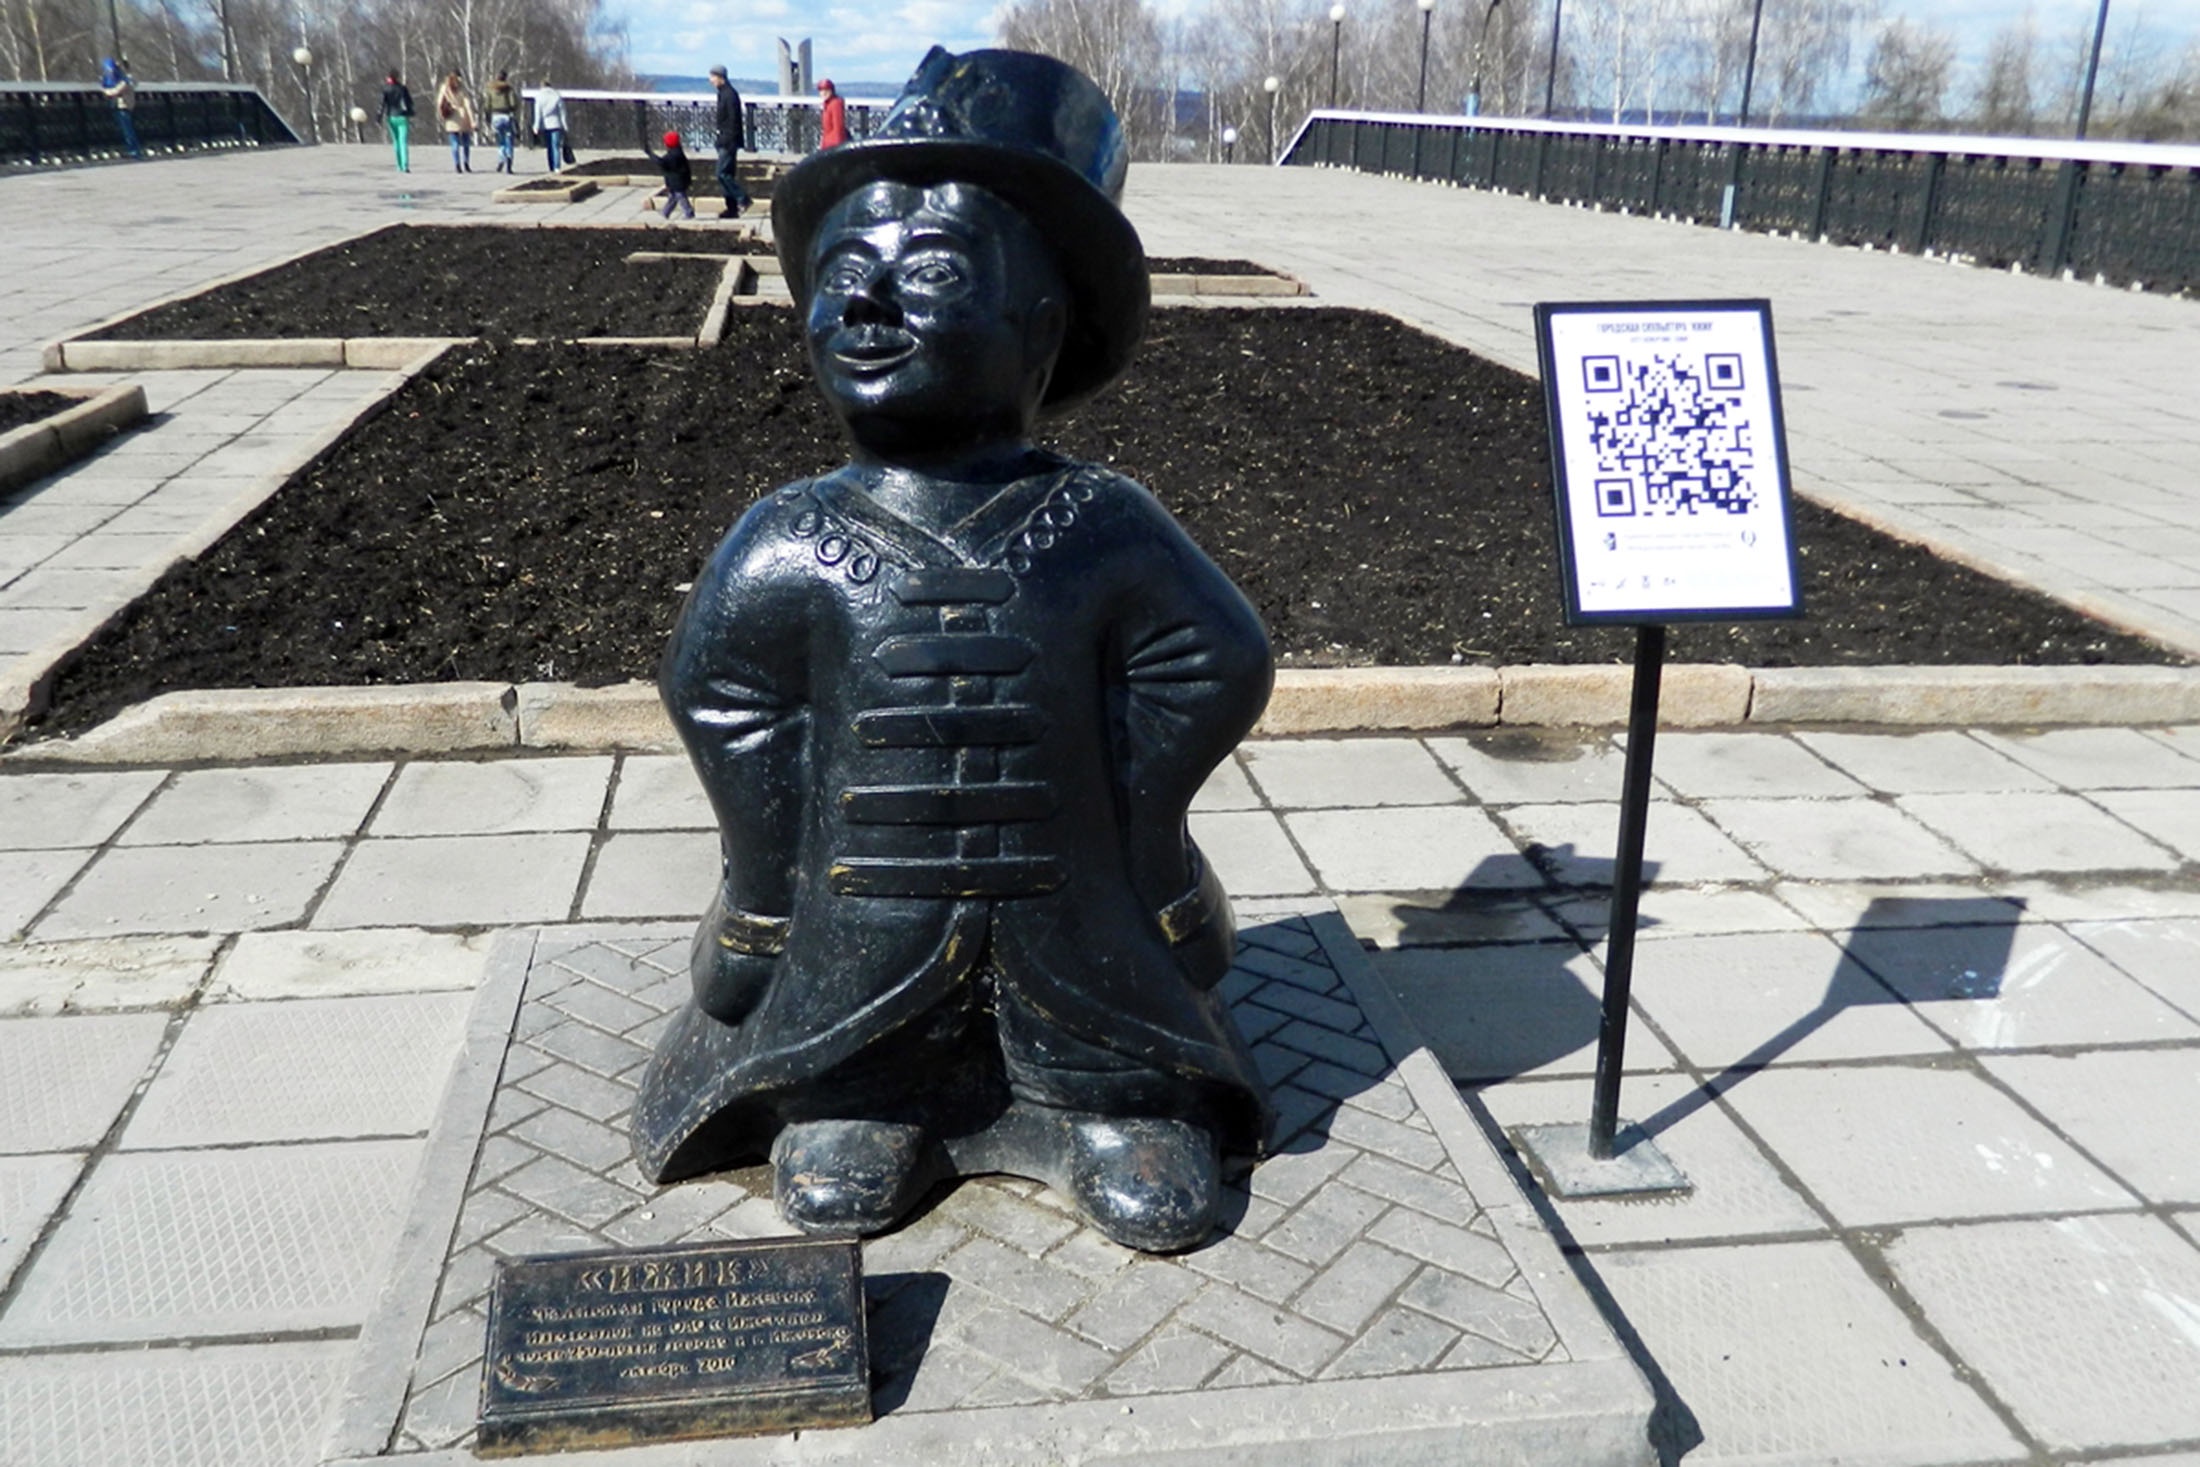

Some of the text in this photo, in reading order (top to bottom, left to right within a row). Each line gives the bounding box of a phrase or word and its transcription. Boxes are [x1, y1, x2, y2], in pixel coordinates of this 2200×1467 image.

[579, 1258, 770, 1294] «ИЖИК»
[652, 1296, 720, 1317] города
[642, 1323, 663, 1338] на
[669, 1318, 705, 1336] ОАО
[697, 1354, 738, 1375] 2010
